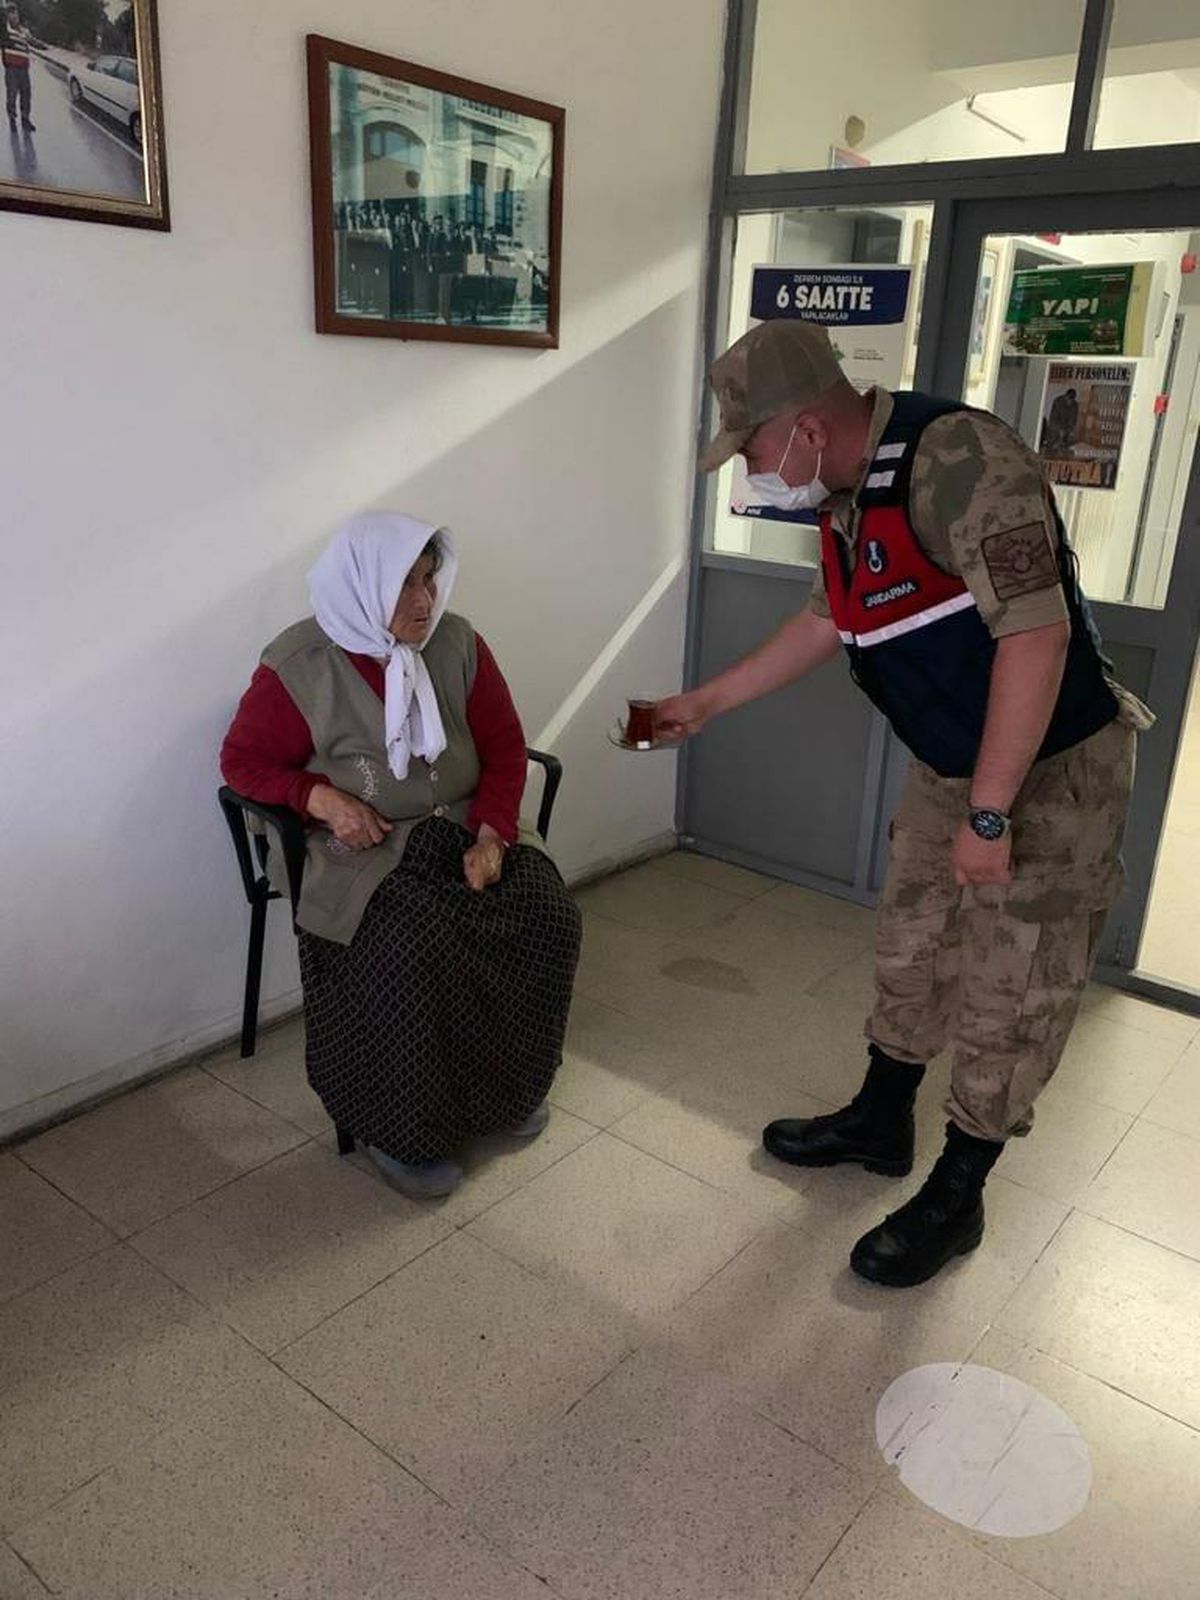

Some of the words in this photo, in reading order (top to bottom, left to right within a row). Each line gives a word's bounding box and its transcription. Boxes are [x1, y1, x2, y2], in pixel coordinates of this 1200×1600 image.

[776, 284, 790, 308] 6
[794, 285, 874, 311] SAATTE
[1042, 298, 1100, 316] YAPI
